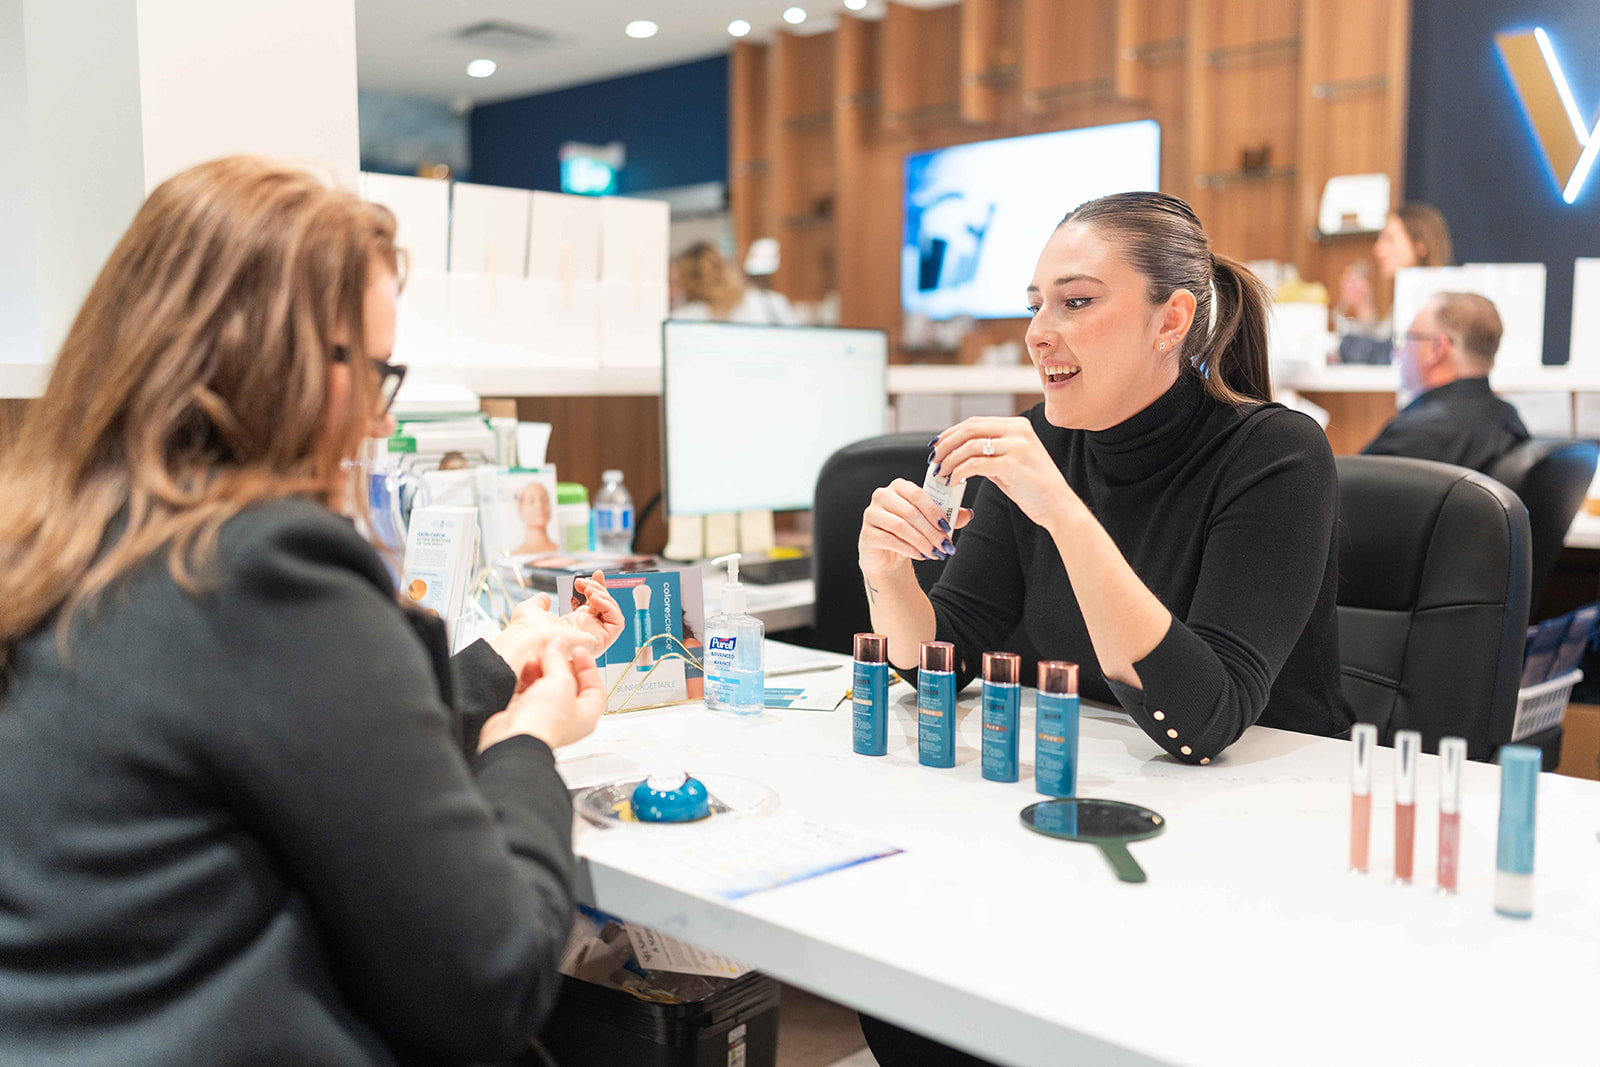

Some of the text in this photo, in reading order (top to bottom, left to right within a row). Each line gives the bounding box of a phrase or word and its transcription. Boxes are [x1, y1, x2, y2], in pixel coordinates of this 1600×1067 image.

[664, 582, 673, 650] coloresciece
[711, 637, 735, 650] Purell
[711, 651, 735, 659] ADVANCED
